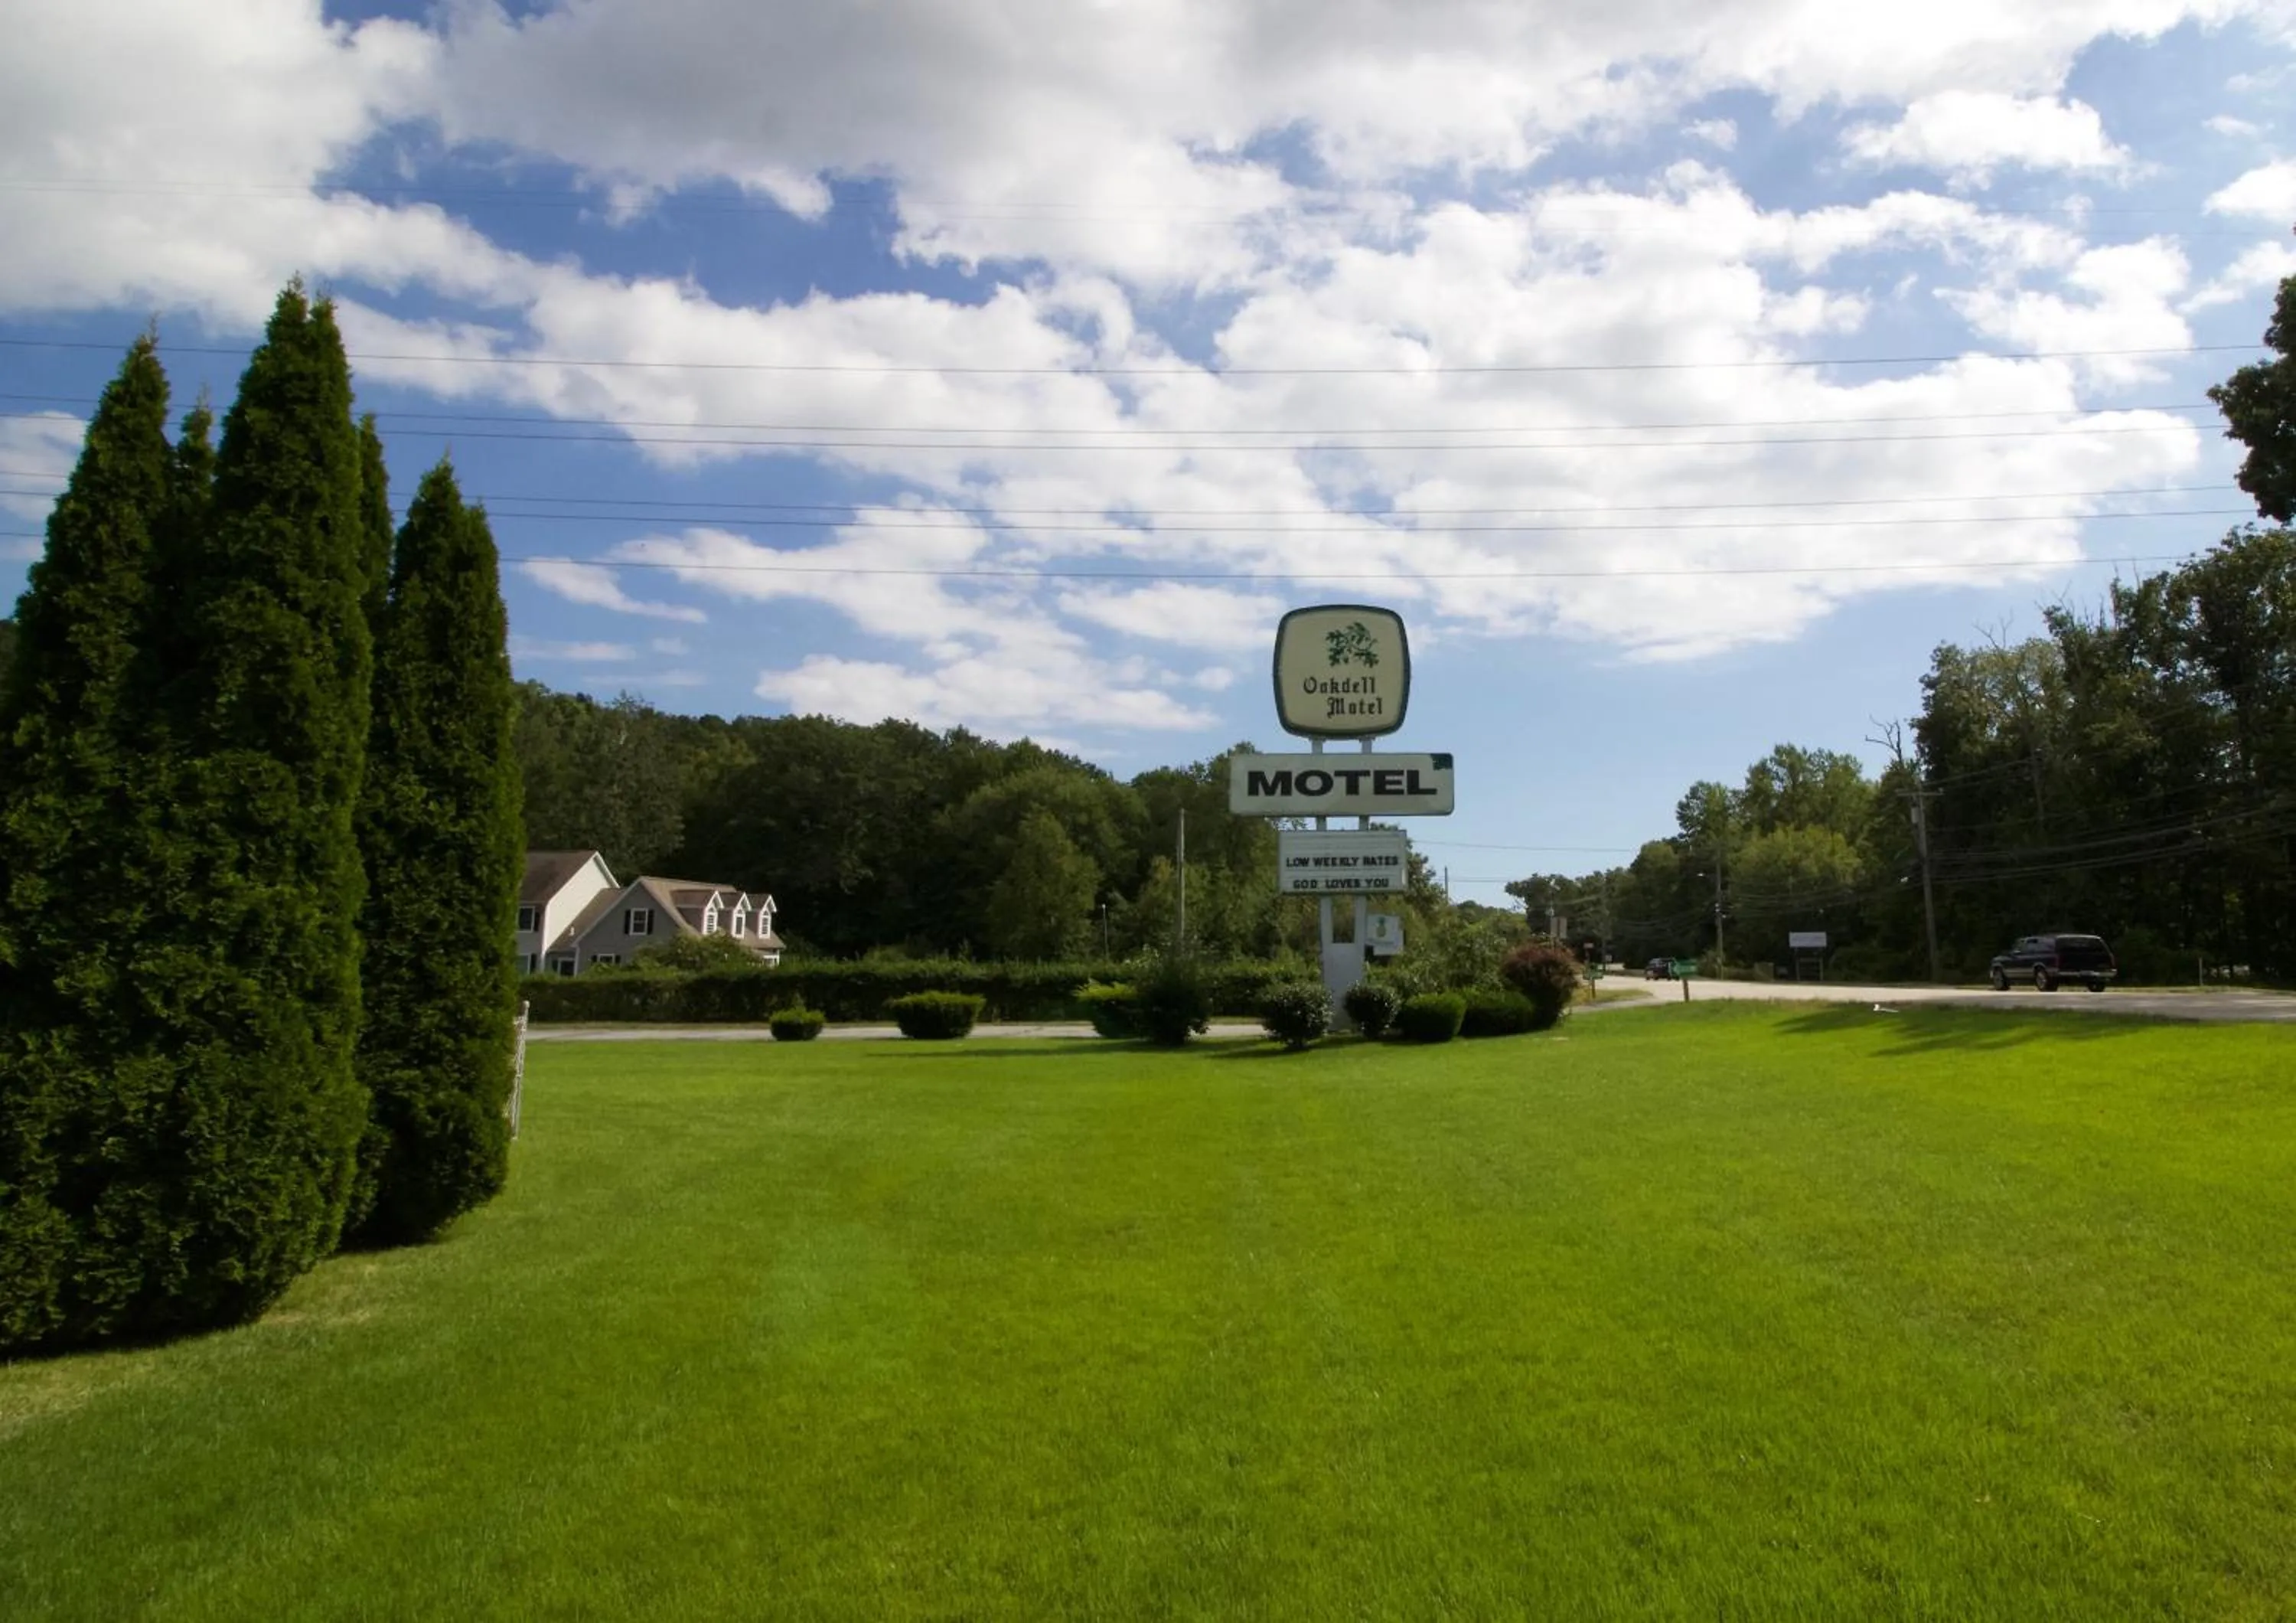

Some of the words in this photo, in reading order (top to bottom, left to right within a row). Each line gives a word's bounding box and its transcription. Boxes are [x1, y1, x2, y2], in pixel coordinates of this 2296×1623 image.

[1303, 677, 1376, 694] Oakdell
[1327, 697, 1382, 718] Motel
[1247, 769, 1437, 797] MOTEL
[1286, 857, 1309, 867] LOW
[1312, 857, 1359, 867] WEEKLY
[1362, 855, 1399, 866] RATES
[1293, 879, 1318, 889] GOD
[1325, 879, 1360, 888] LOVES
[1365, 878, 1389, 887] YOU
